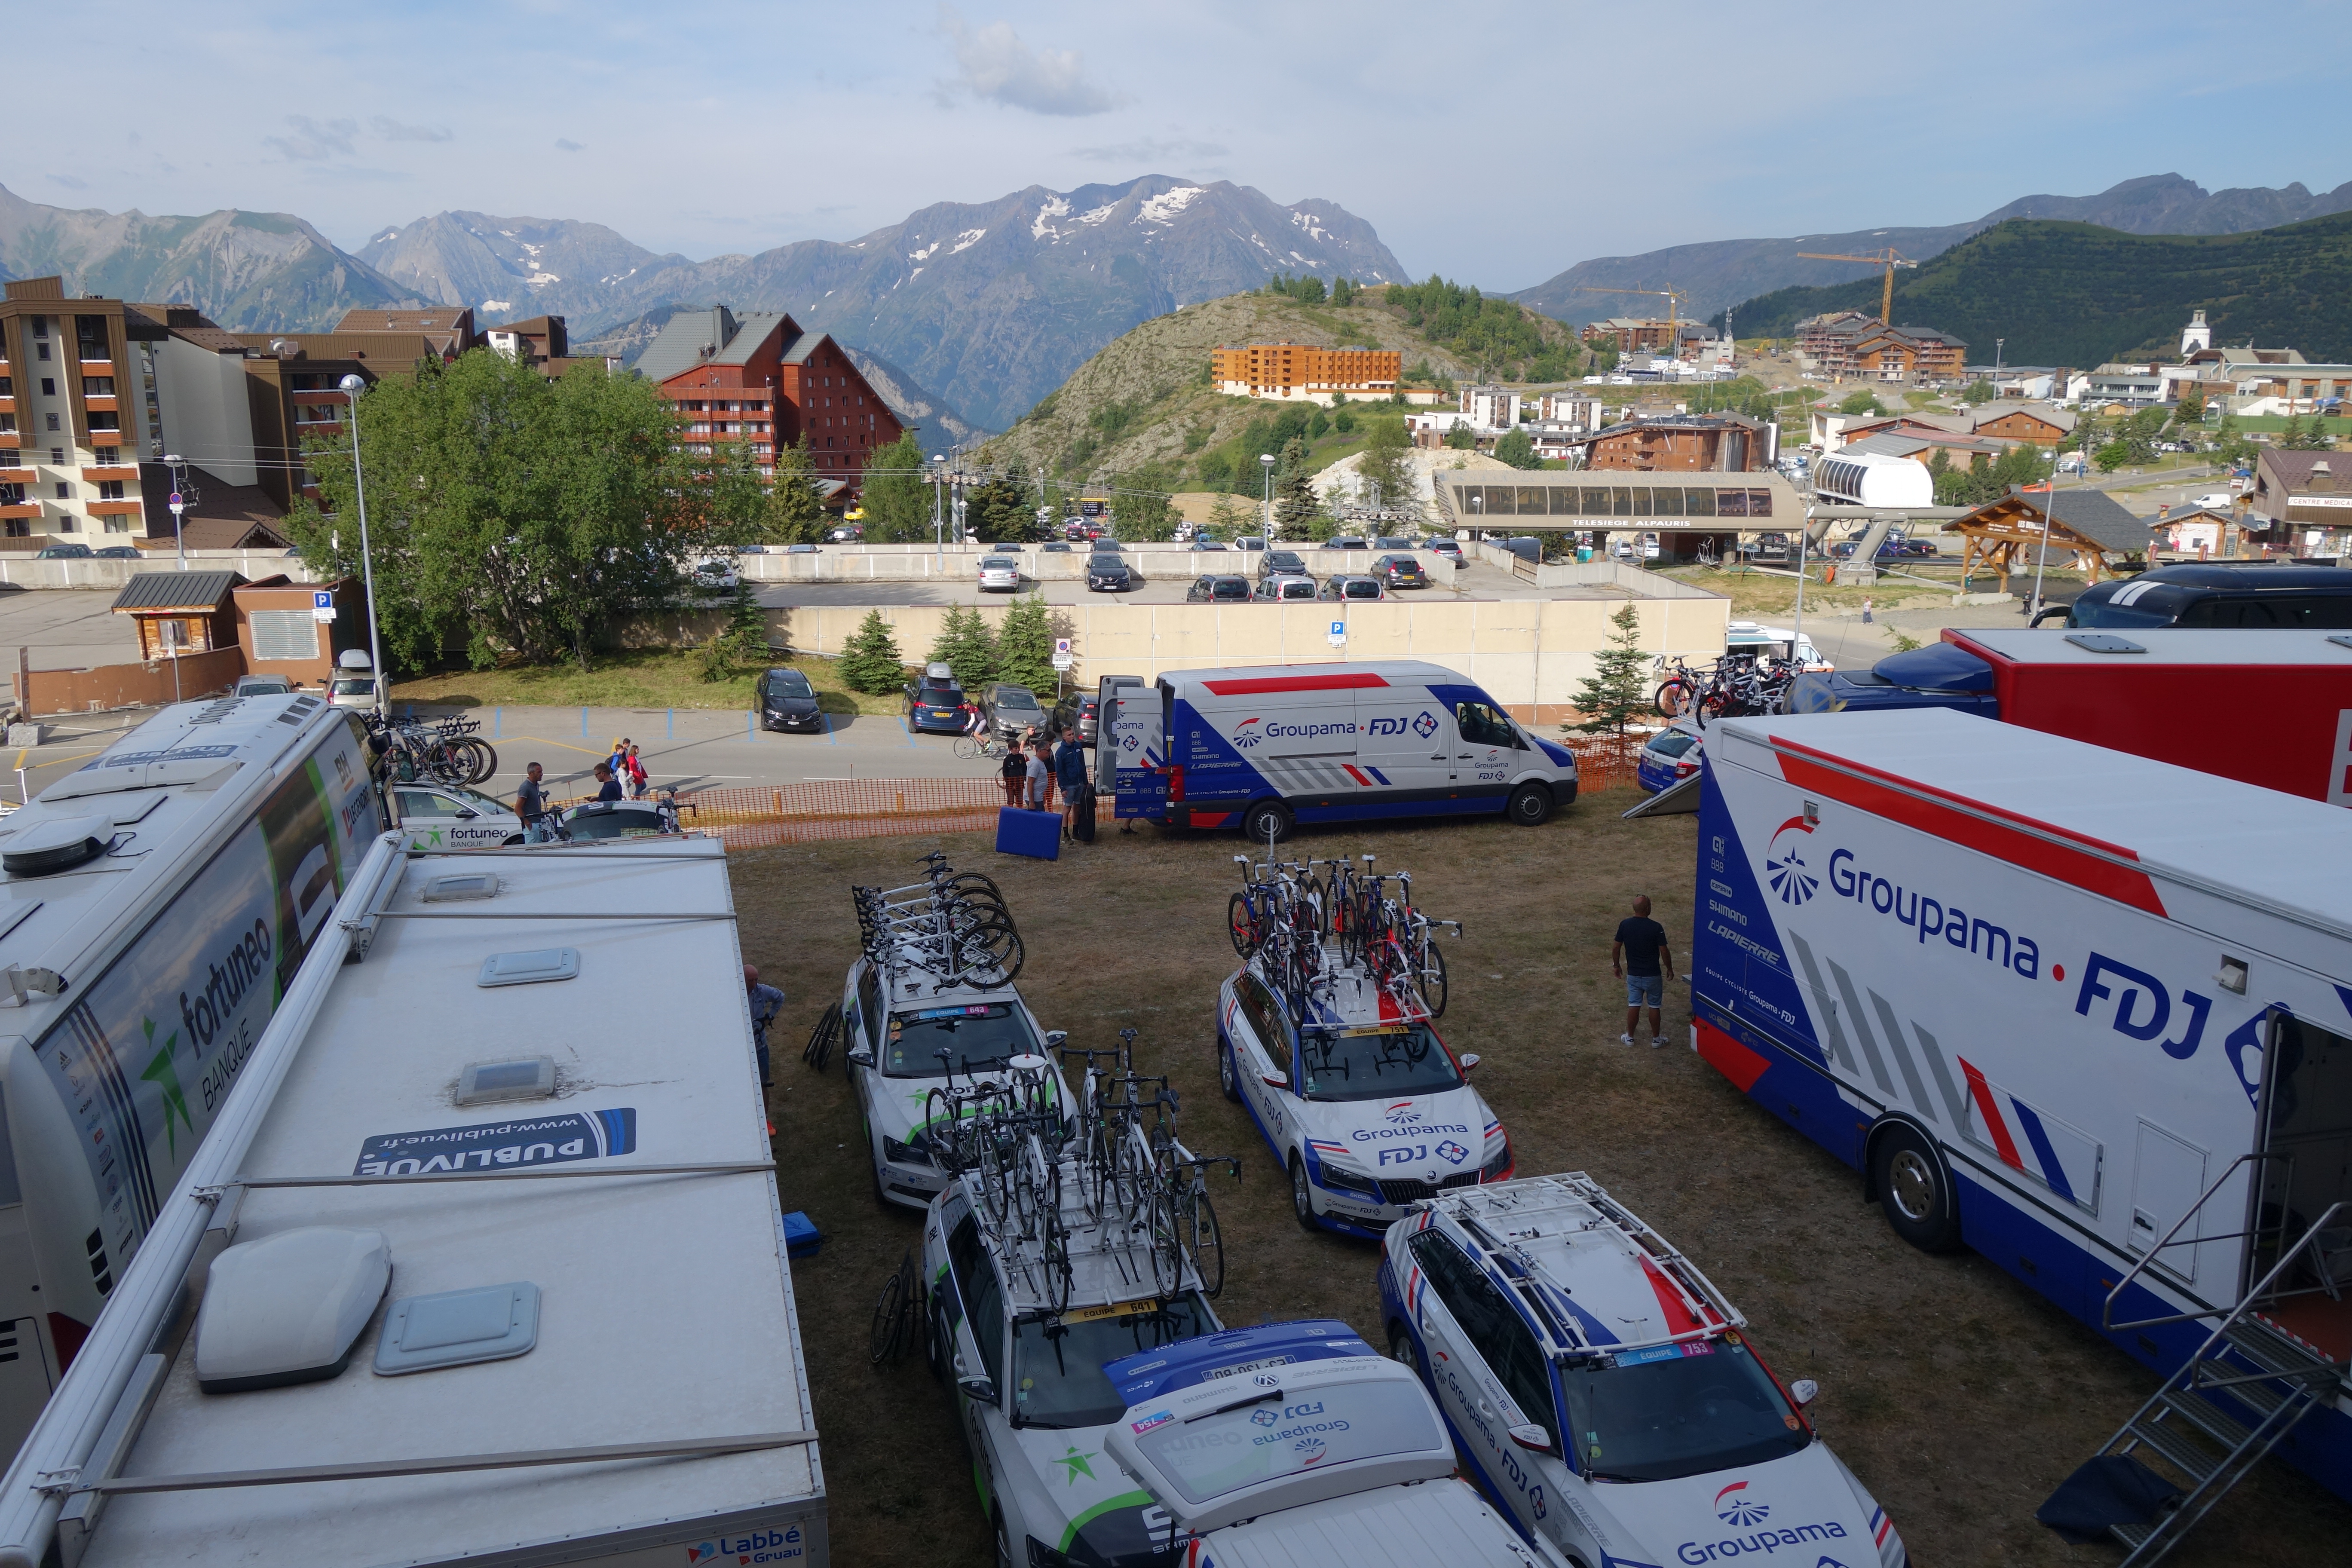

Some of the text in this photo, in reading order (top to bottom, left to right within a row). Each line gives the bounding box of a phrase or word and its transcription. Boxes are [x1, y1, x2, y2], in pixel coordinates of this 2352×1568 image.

[319, 595, 328, 606] P
[1334, 625, 1341, 633] P
[1266, 717, 1408, 739] Groupama FDJ
[113, 745, 233, 761] PUBLIVUE
[334, 750, 352, 784] BH
[349, 786, 370, 825] LEGENDRE
[450, 828, 508, 839] fortuneo
[1711, 858, 1724, 873] BBB
[1709, 899, 1747, 926] SHIMANO
[1708, 920, 1780, 965] LAPIERRE
[1829, 848, 2213, 1060] Groupama FDJ
[180, 918, 271, 1060] fortuneo
[1706, 966, 1795, 1025] ÉQUIPE CYCLISTE Groupama FDJ
[202, 1017, 252, 1113] BANQUE
[1242, 1058, 1275, 1121] Groupama FDJ
[379, 1118, 579, 1149] www.publivue.fr
[1290, 1107, 1313, 1135] LAPIERRE
[1352, 1124, 1468, 1142] Groupama
[361, 1138, 585, 1175] PUBLIVUE
[1378, 1145, 1427, 1167] FDJ
[1332, 1201, 1357, 1211] Groupama
[929, 1225, 938, 1242] BH
[1386, 1258, 1402, 1304] LAPIERRE
[1083, 1300, 1152, 1318] ÉQUIPE 641
[1155, 1342, 1174, 1352] FDJ
[1224, 1341, 1246, 1349] BBB
[1640, 1341, 1708, 1360] ÉQUIPE 753
[1292, 1365, 1378, 1378] LAPIERRE
[1182, 1386, 1238, 1404] SHIMANO
[1484, 1378, 1500, 1400] Groupama
[1498, 1399, 1509, 1411] FDJ
[1284, 1401, 1324, 1419] FDJ
[1137, 1417, 1158, 1430] 754
[1252, 1420, 1350, 1446] Groupama
[1449, 1372, 1528, 1491] Groupama FDJ
[969, 1404, 994, 1488] fortuneo
[1563, 1489, 1612, 1547] LAPIERRE
[721, 1526, 801, 1555] Labbé
[1677, 1521, 1848, 1566] Groupama
[753, 1546, 802, 1564] Gruau
